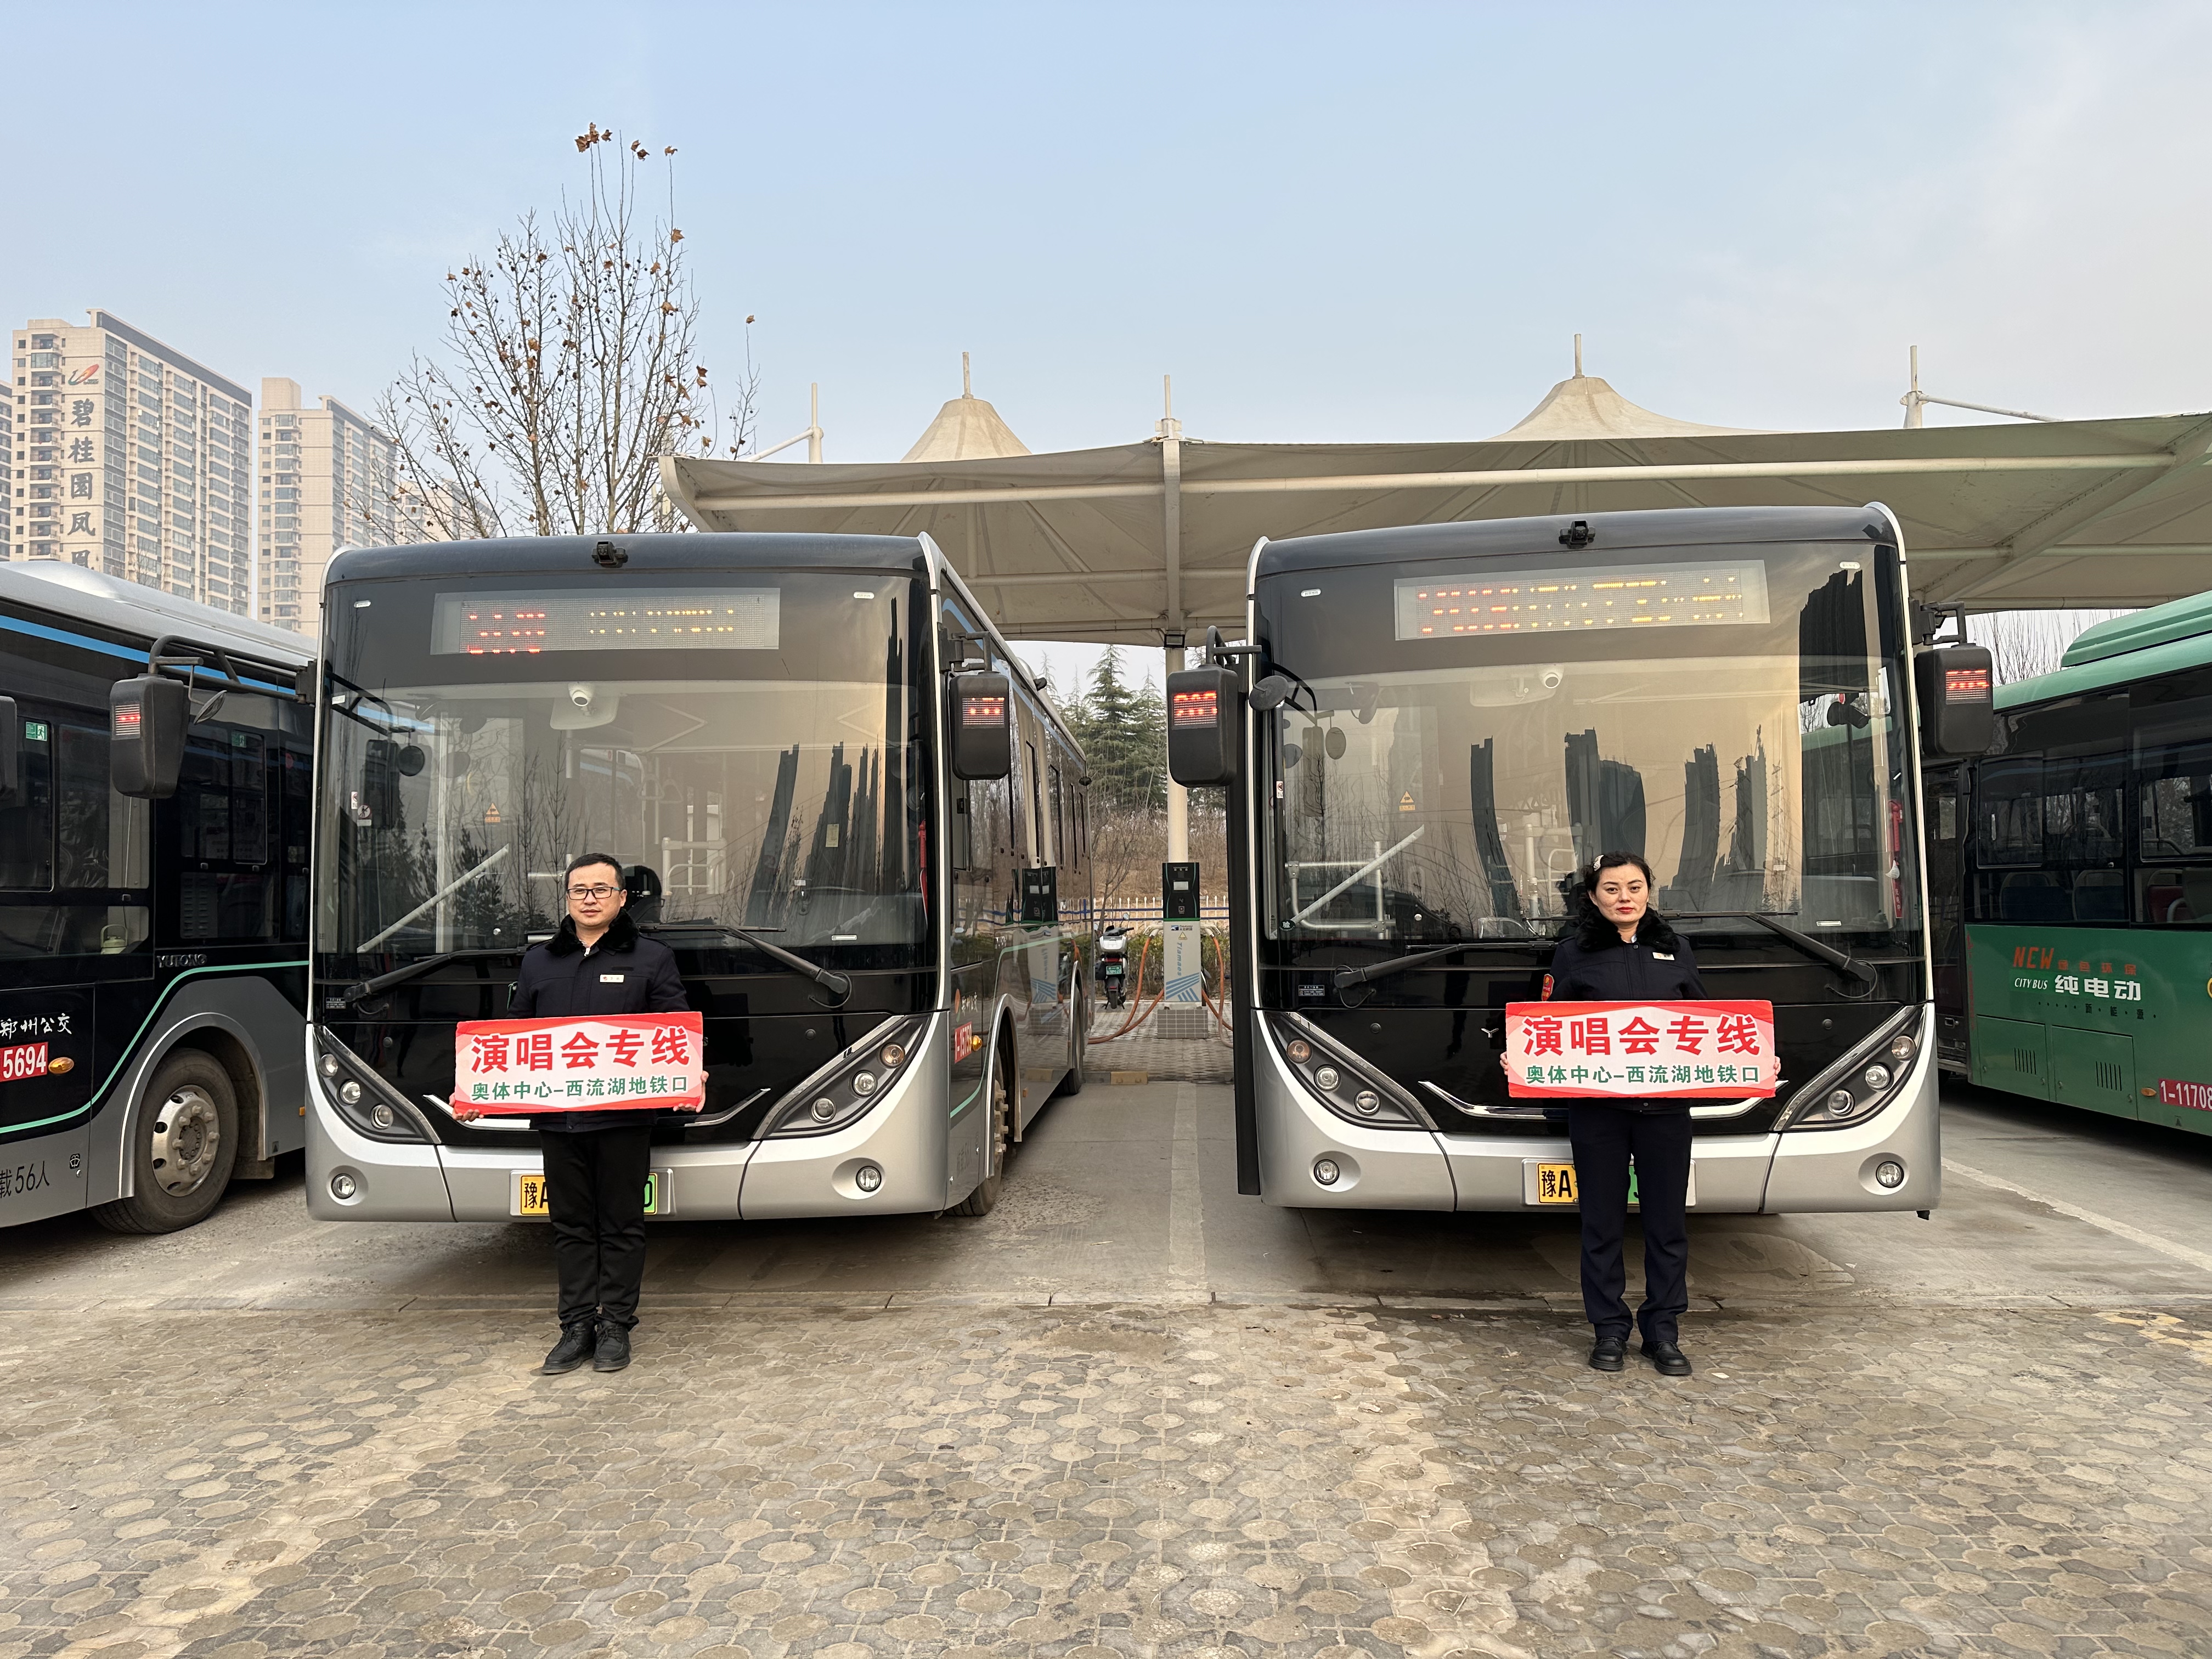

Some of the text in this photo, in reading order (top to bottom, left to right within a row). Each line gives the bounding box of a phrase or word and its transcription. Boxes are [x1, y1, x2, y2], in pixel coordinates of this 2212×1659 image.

[156, 953, 207, 968] YUTONG
[2015, 978, 2048, 990] CITY BUS
[2055, 975, 2141, 1001] 纯电动
[470, 1026, 690, 1074] 演唱会专线
[1522, 1015, 1760, 1056] 演唱会专线
[3, 1045, 46, 1078] 5694
